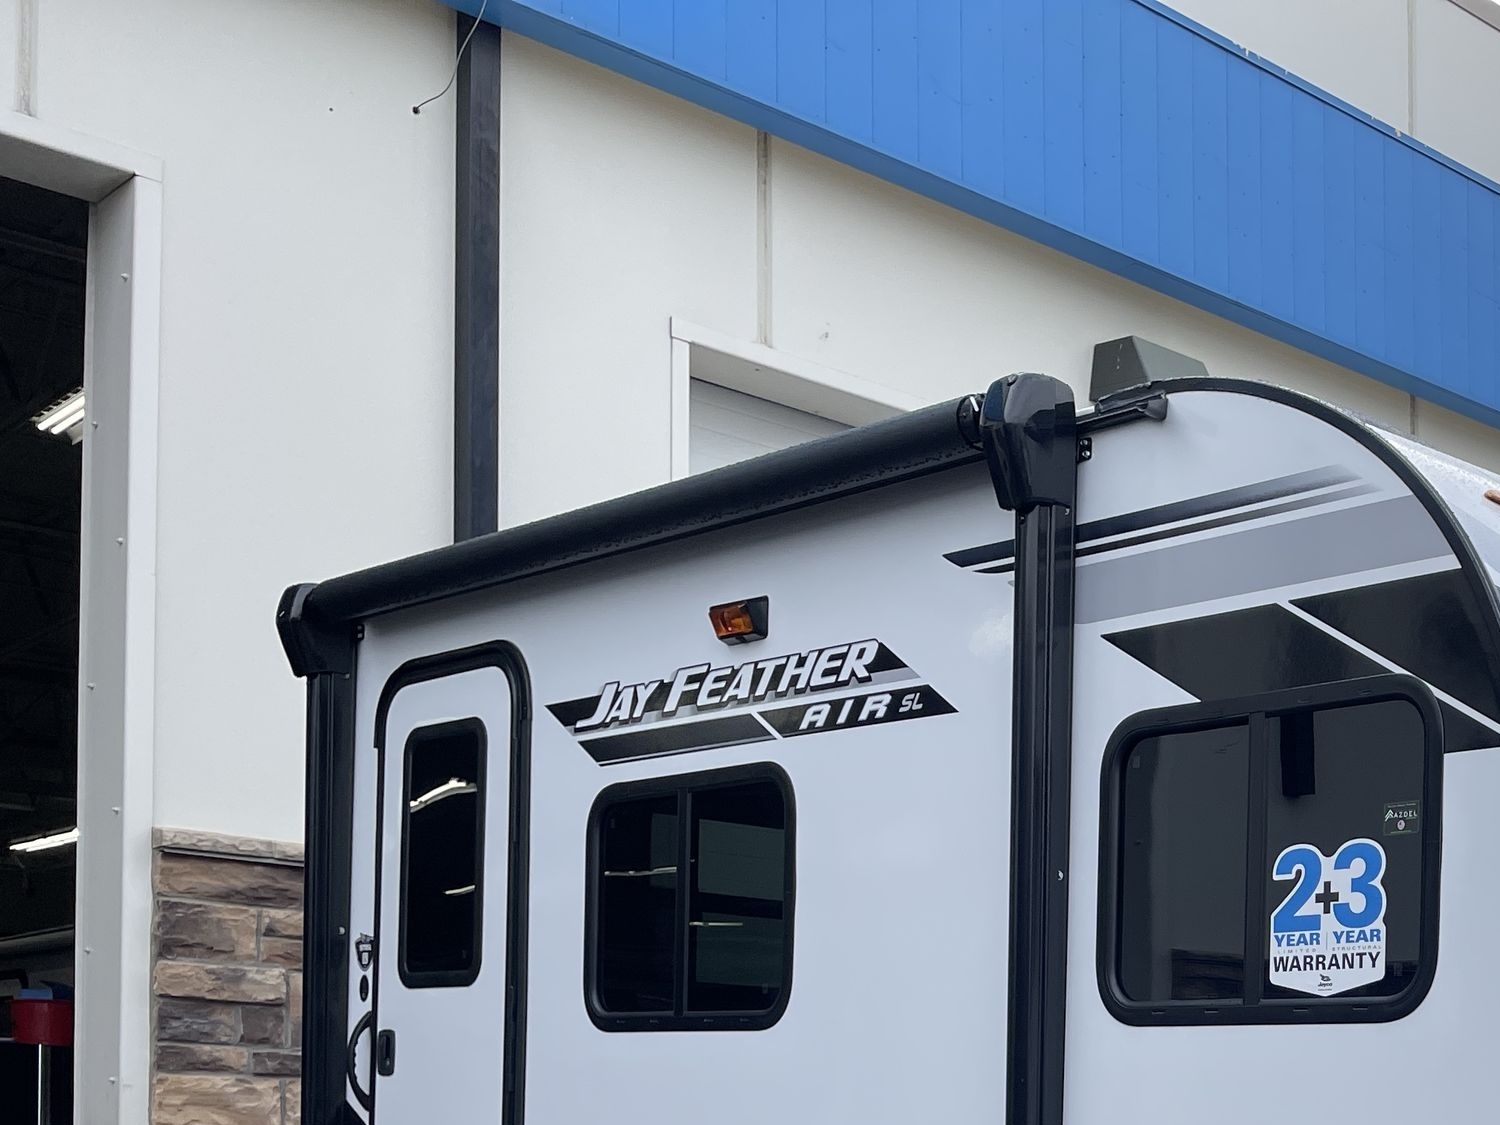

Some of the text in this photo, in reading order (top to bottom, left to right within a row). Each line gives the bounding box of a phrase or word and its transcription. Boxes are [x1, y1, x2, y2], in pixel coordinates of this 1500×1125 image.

[574, 639, 879, 732] JAY FEATHER
[799, 692, 923, 731] AIR SL
[1274, 929, 1381, 947] YEAR YEAR
[1273, 951, 1381, 973] WARRANTY
